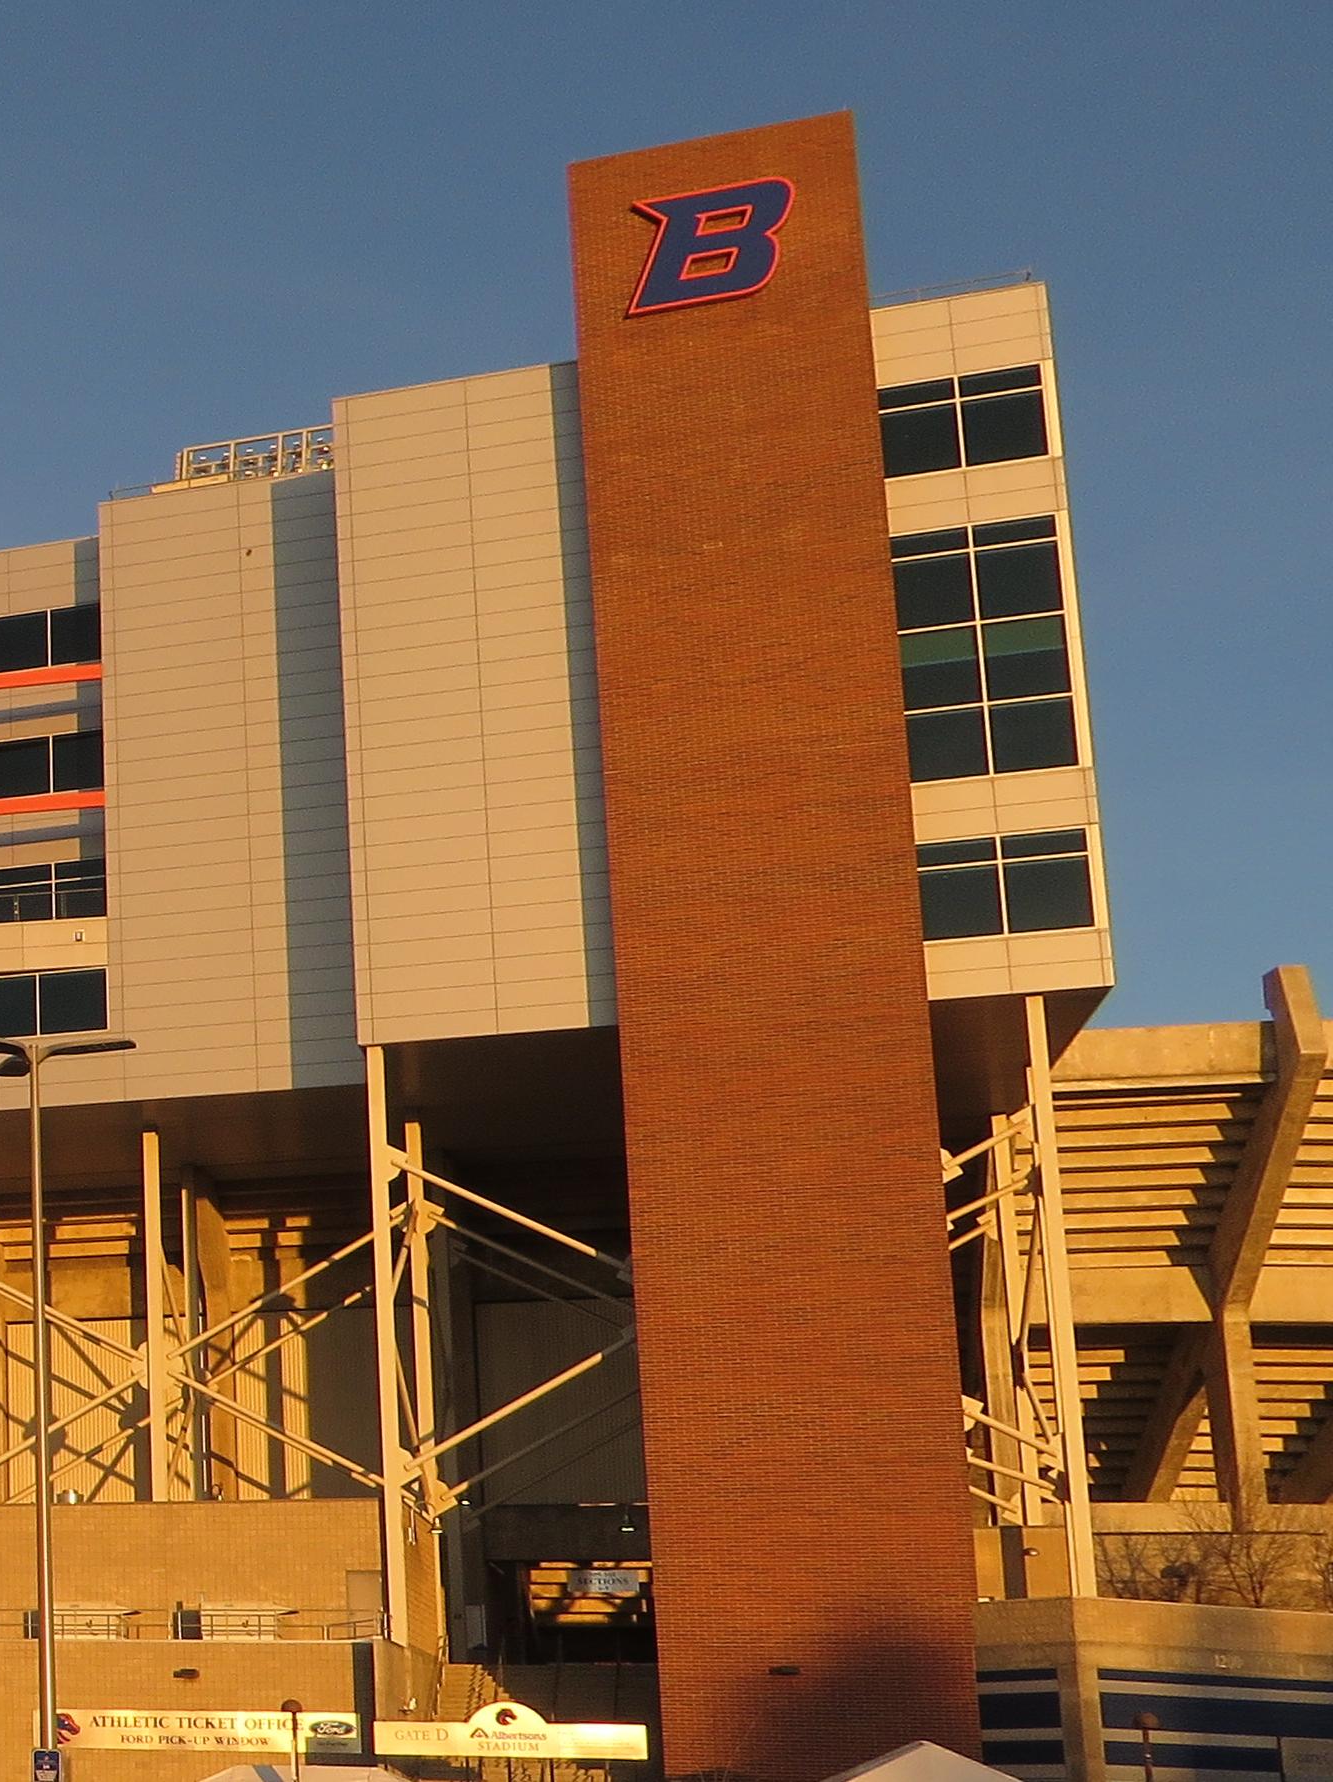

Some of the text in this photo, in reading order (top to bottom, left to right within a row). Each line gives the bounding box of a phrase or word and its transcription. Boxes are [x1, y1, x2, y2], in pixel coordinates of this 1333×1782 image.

[626, 176, 795, 317] B
[90, 1716, 304, 1731] ATHLETIC TICKET OFFICE
[395, 1727, 449, 1741] GATE D
[491, 1731, 547, 1741] Albertsons
[121, 1735, 271, 1746] FORD PICK-UP WINDOW
[477, 1741, 540, 1752] STADIUM
